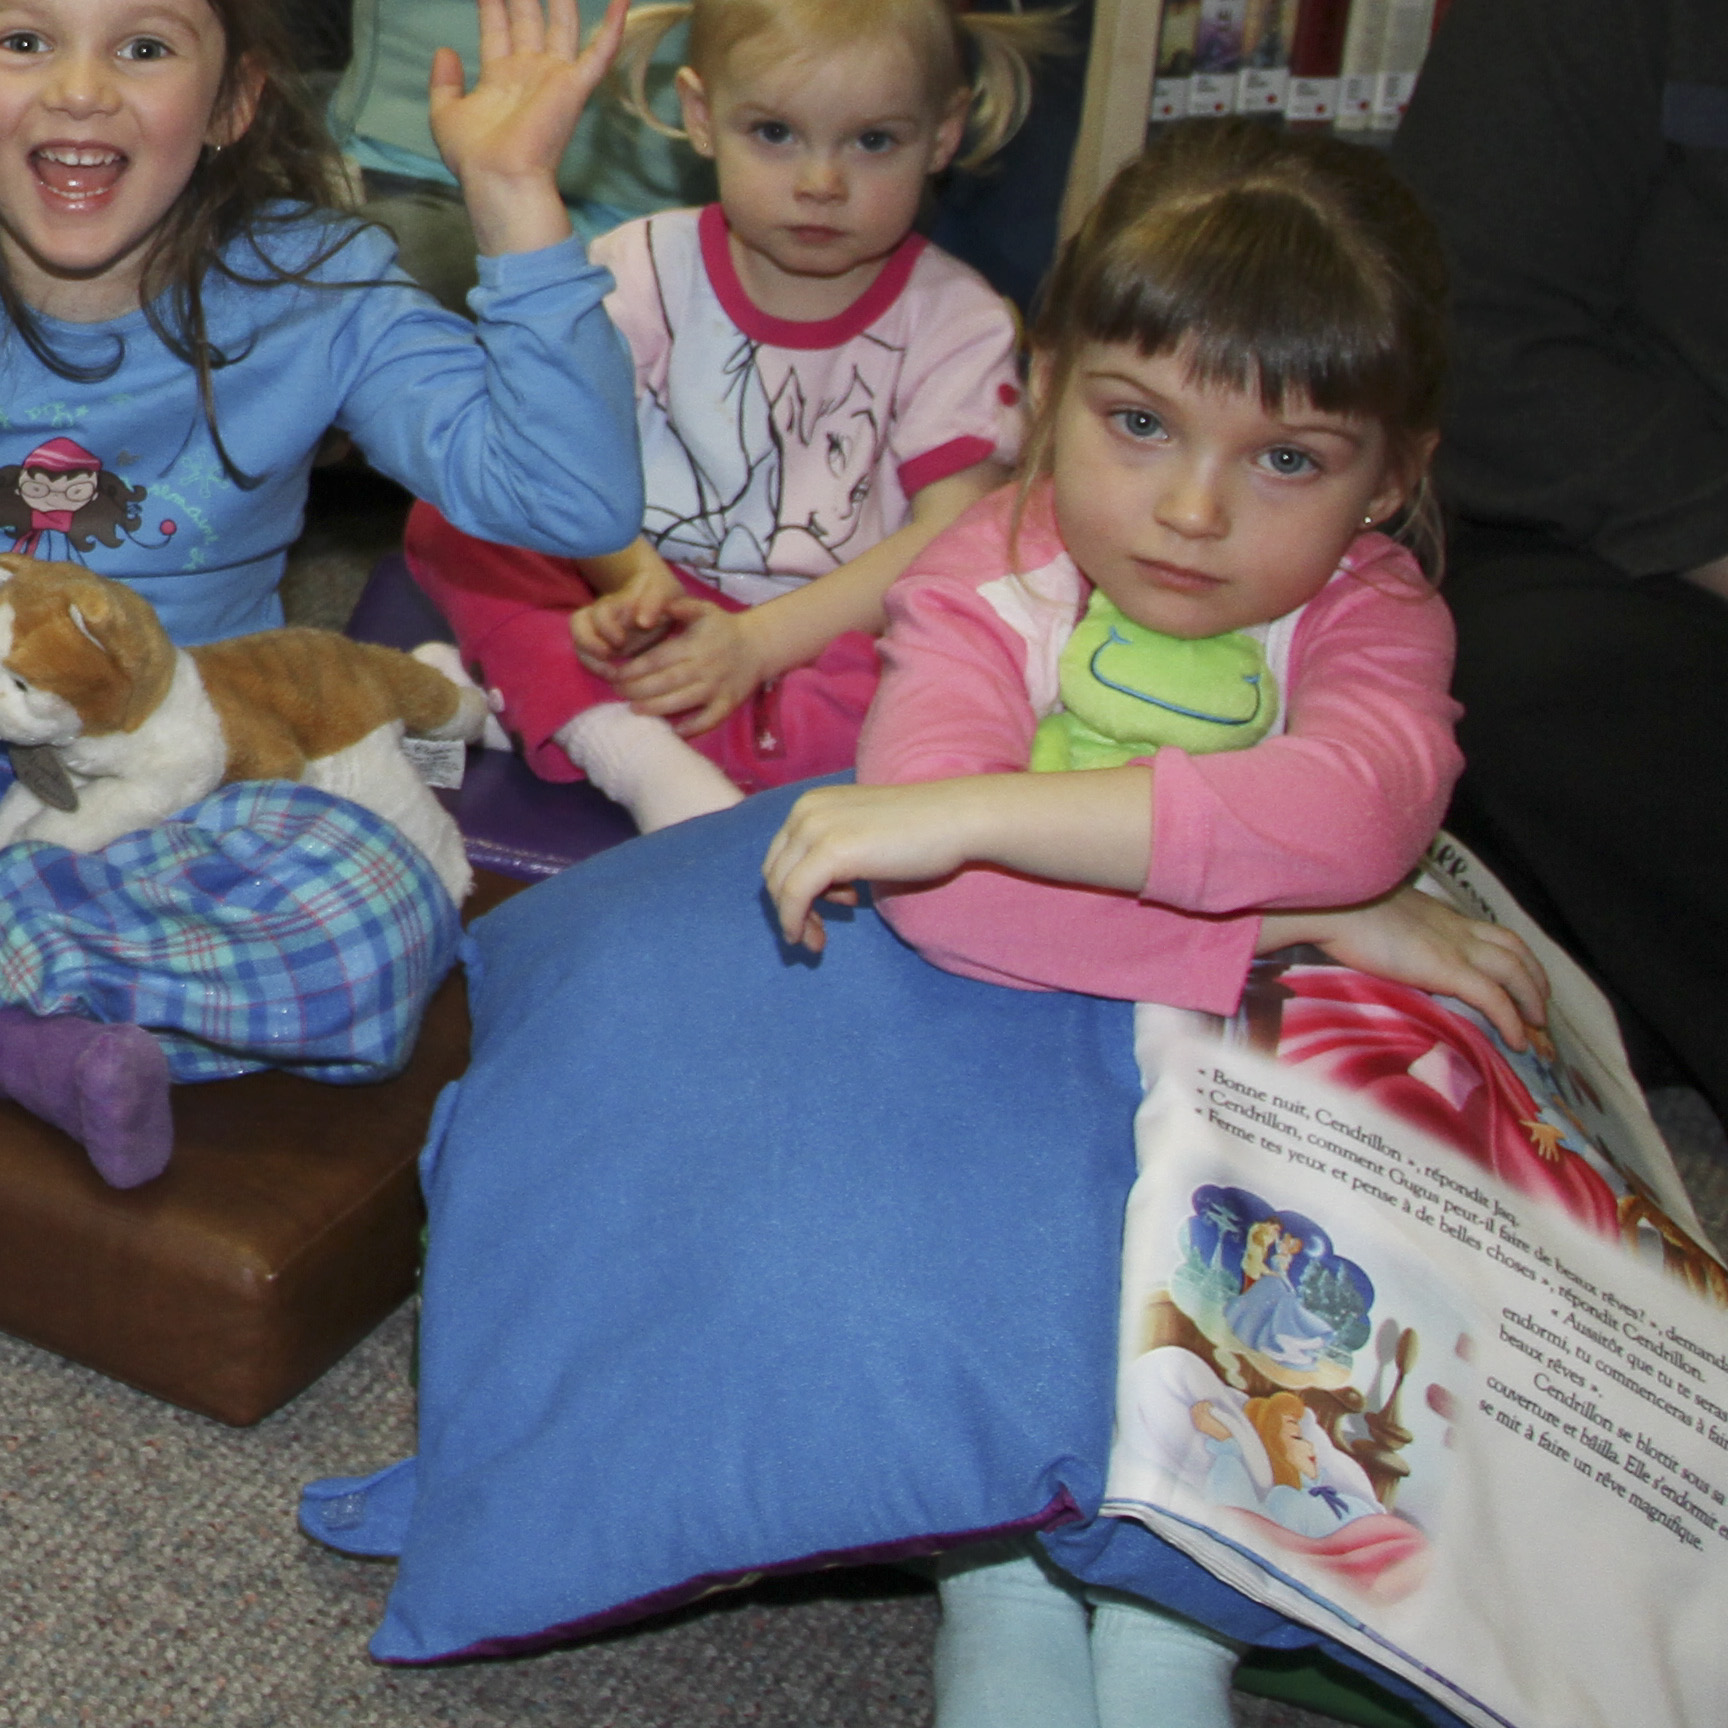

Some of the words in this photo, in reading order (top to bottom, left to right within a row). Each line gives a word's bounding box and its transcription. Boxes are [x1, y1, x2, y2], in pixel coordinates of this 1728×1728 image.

[1208, 1089, 1303, 1142] Cendrillon,
[1306, 1133, 1385, 1177] comment
[1388, 1167, 1441, 1205] Gugus
[1443, 1199, 1496, 1234] peut-il
[1498, 1224, 1531, 1254] faire
[1533, 1246, 1553, 1267] de
[1554, 1257, 1599, 1298] beaux
[1212, 1068, 1268, 1102] Bonne
[1272, 1094, 1312, 1121] nuit,
[1314, 1107, 1403, 1163] Cendrillon
[1424, 1164, 1491, 1210] répondit
[1207, 1107, 1256, 1145] Ferme
[1259, 1135, 1283, 1156] tes
[1287, 1147, 1328, 1173] yeux
[1330, 1166, 1349, 1184] et
[1351, 1175, 1399, 1208] pense
[1401, 1198, 1412, 1213] à
[1414, 1205, 1436, 1227] de
[1438, 1215, 1483, 1252] belles
[1485, 1244, 1537, 1282] choses
[1557, 1284, 1620, 1333] répondit
[1622, 1322, 1707, 1384] Cendrillon.
[1498, 1323, 1545, 1364] beaux
[1546, 1357, 1587, 1389] rêves
[1501, 1306, 1571, 1356] endormi,
[1574, 1345, 1592, 1366] tu
[1594, 1359, 1694, 1429] commenceras
[1694, 1417, 1705, 1435] à
[1562, 1311, 1624, 1359] Aussitôt
[1626, 1352, 1655, 1378] que
[1656, 1369, 1674, 1390] tu
[1676, 1380, 1693, 1400] te
[1693, 1392, 1728, 1424] seras
[1478, 1398, 1495, 1417] se
[1495, 1409, 1523, 1436] mit
[1524, 1423, 1536, 1442] à
[1537, 1430, 1571, 1464] faire
[1572, 1456, 1594, 1478] un
[1594, 1469, 1628, 1500] rêve
[1627, 1491, 1705, 1553] magnifique.
[1485, 1374, 1562, 1429] couverture
[1562, 1421, 1579, 1440] et
[1623, 1453, 1653, 1486] Elle
[1651, 1474, 1720, 1532] s'endormit
[1533, 1371, 1614, 1434] Cendrillon
[1615, 1425, 1634, 1445] se
[1635, 1431, 1681, 1476] blottit
[1679, 1466, 1711, 1496] sous
[1710, 1487, 1727, 1507] sa
